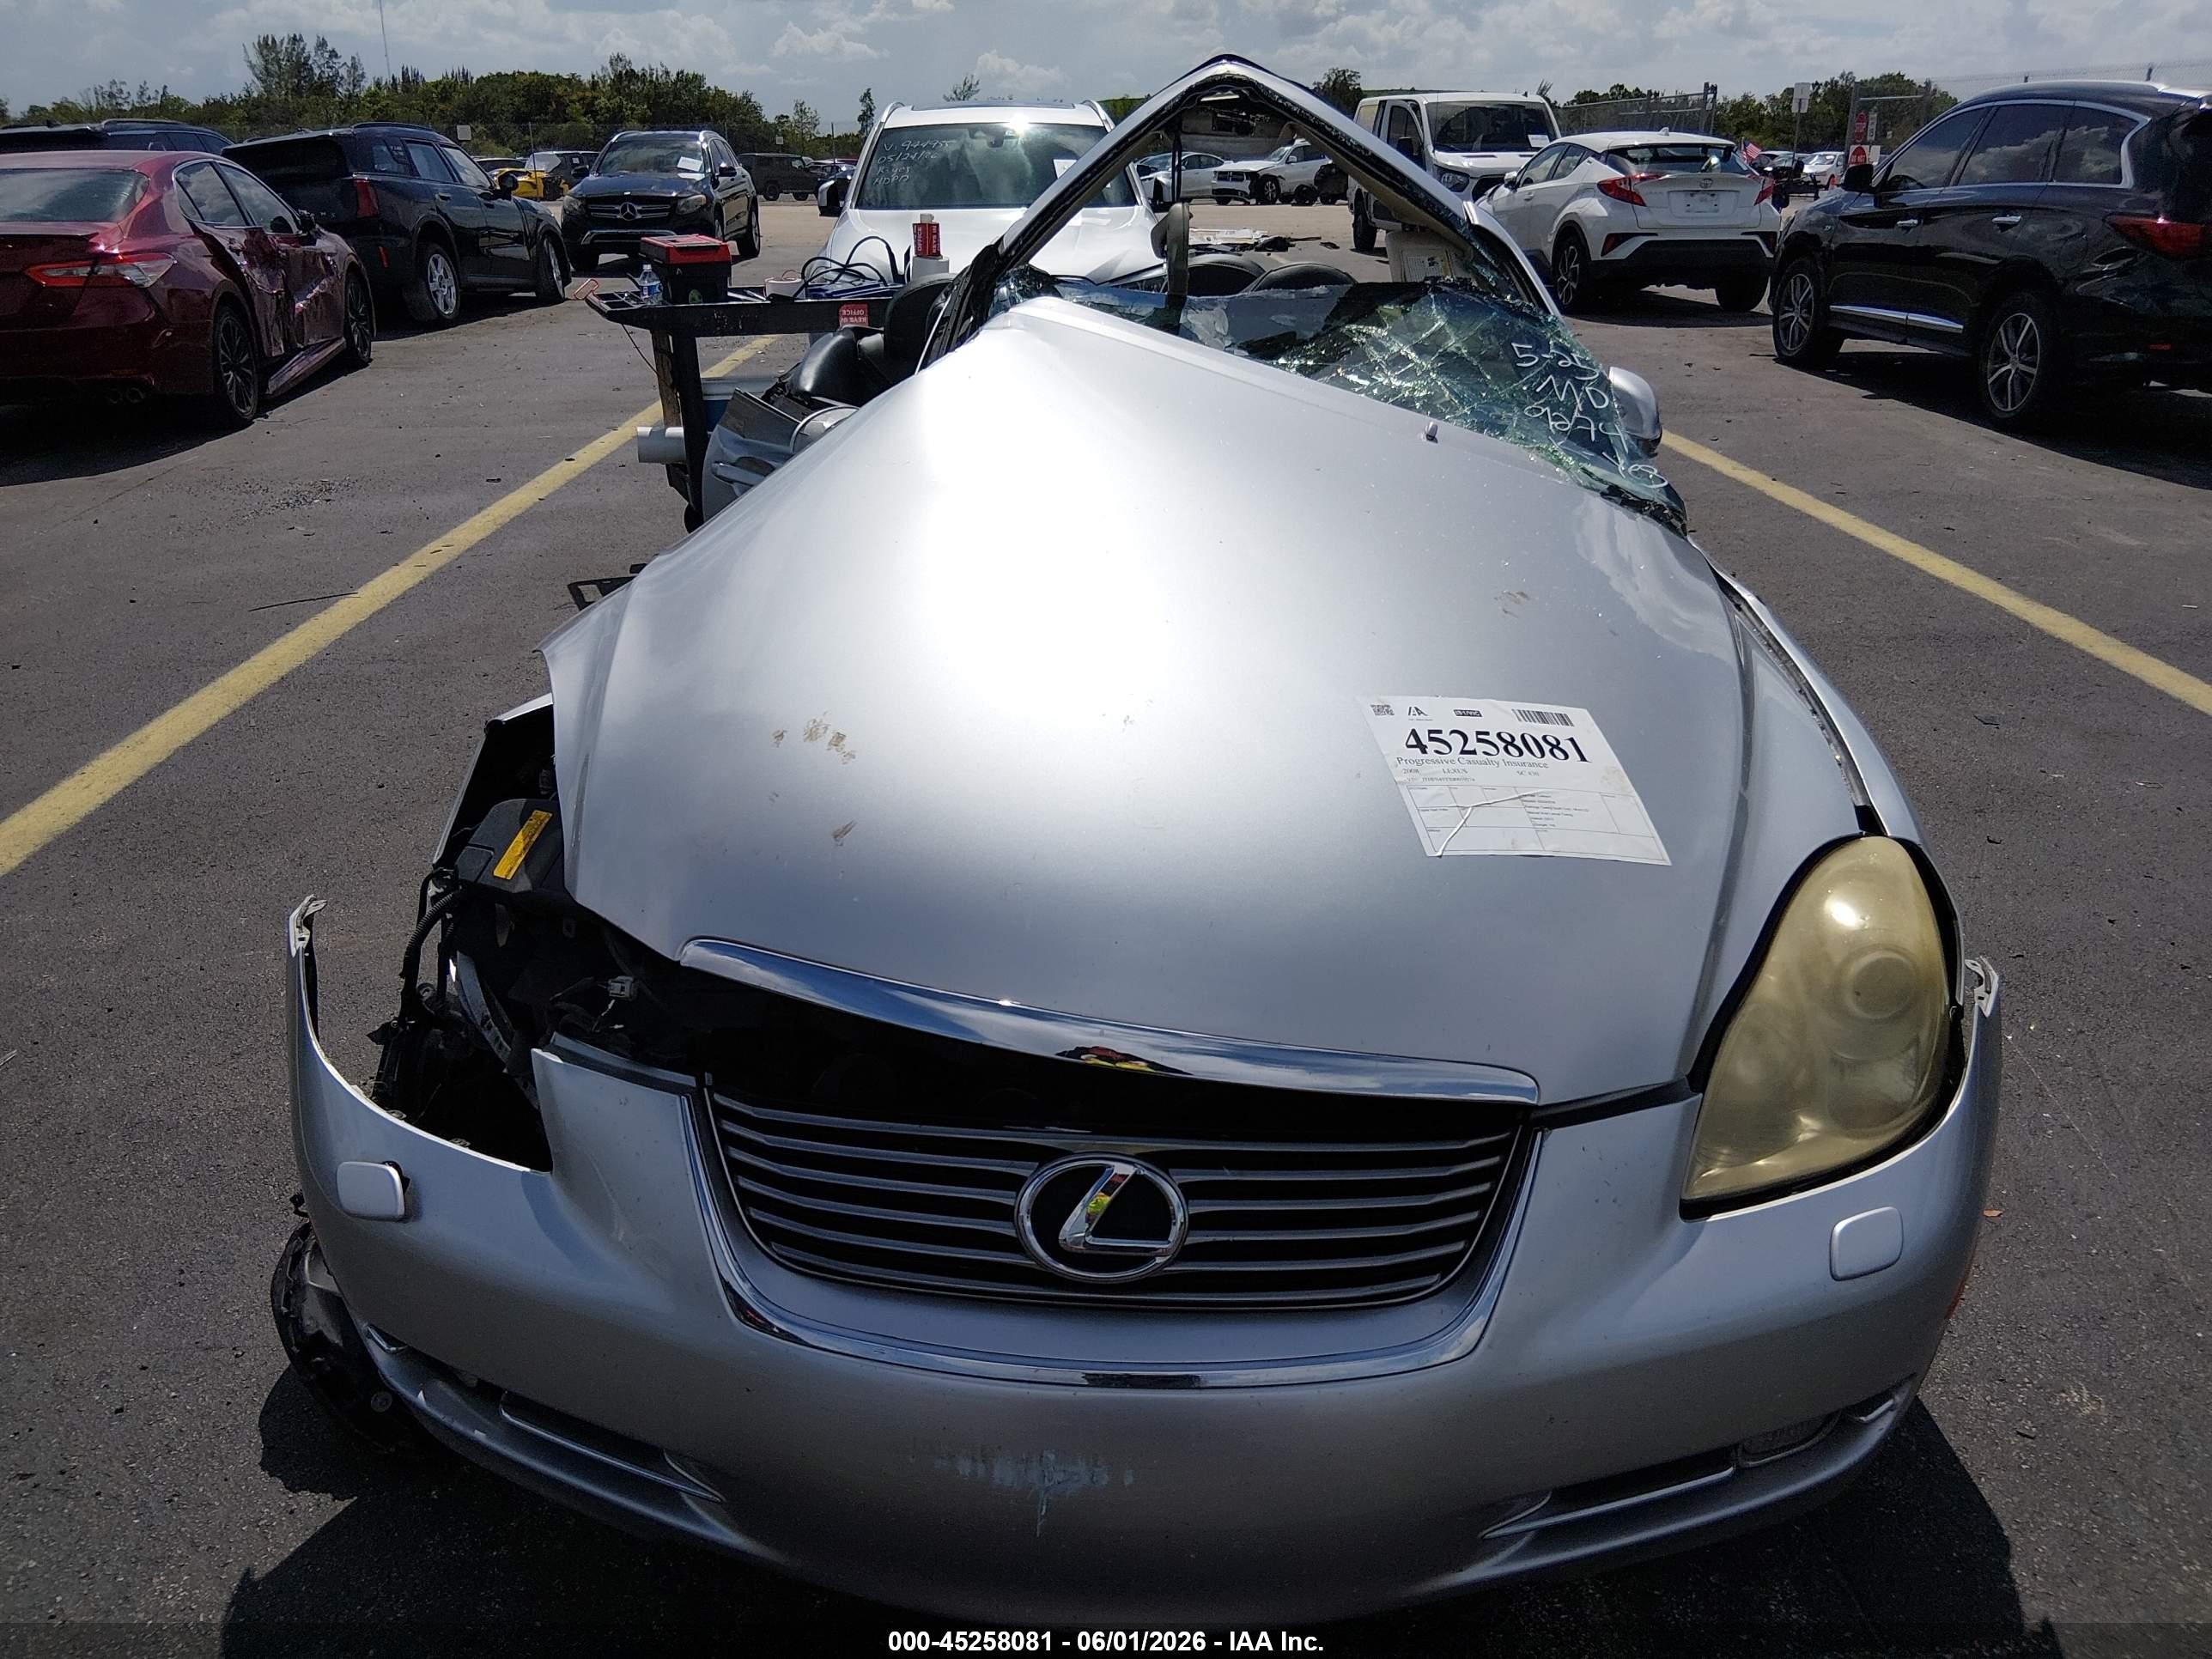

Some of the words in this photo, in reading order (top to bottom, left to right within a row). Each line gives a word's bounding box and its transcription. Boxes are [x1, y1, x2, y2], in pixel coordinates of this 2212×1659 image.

[1510, 343, 1601, 380] 5-25
[1535, 374, 1610, 411] MD
[1396, 757, 1456, 766] Progressive
[1457, 757, 1499, 768] Casualty
[1502, 758, 1549, 769] Insurance
[1405, 728, 1591, 763] 45258081
